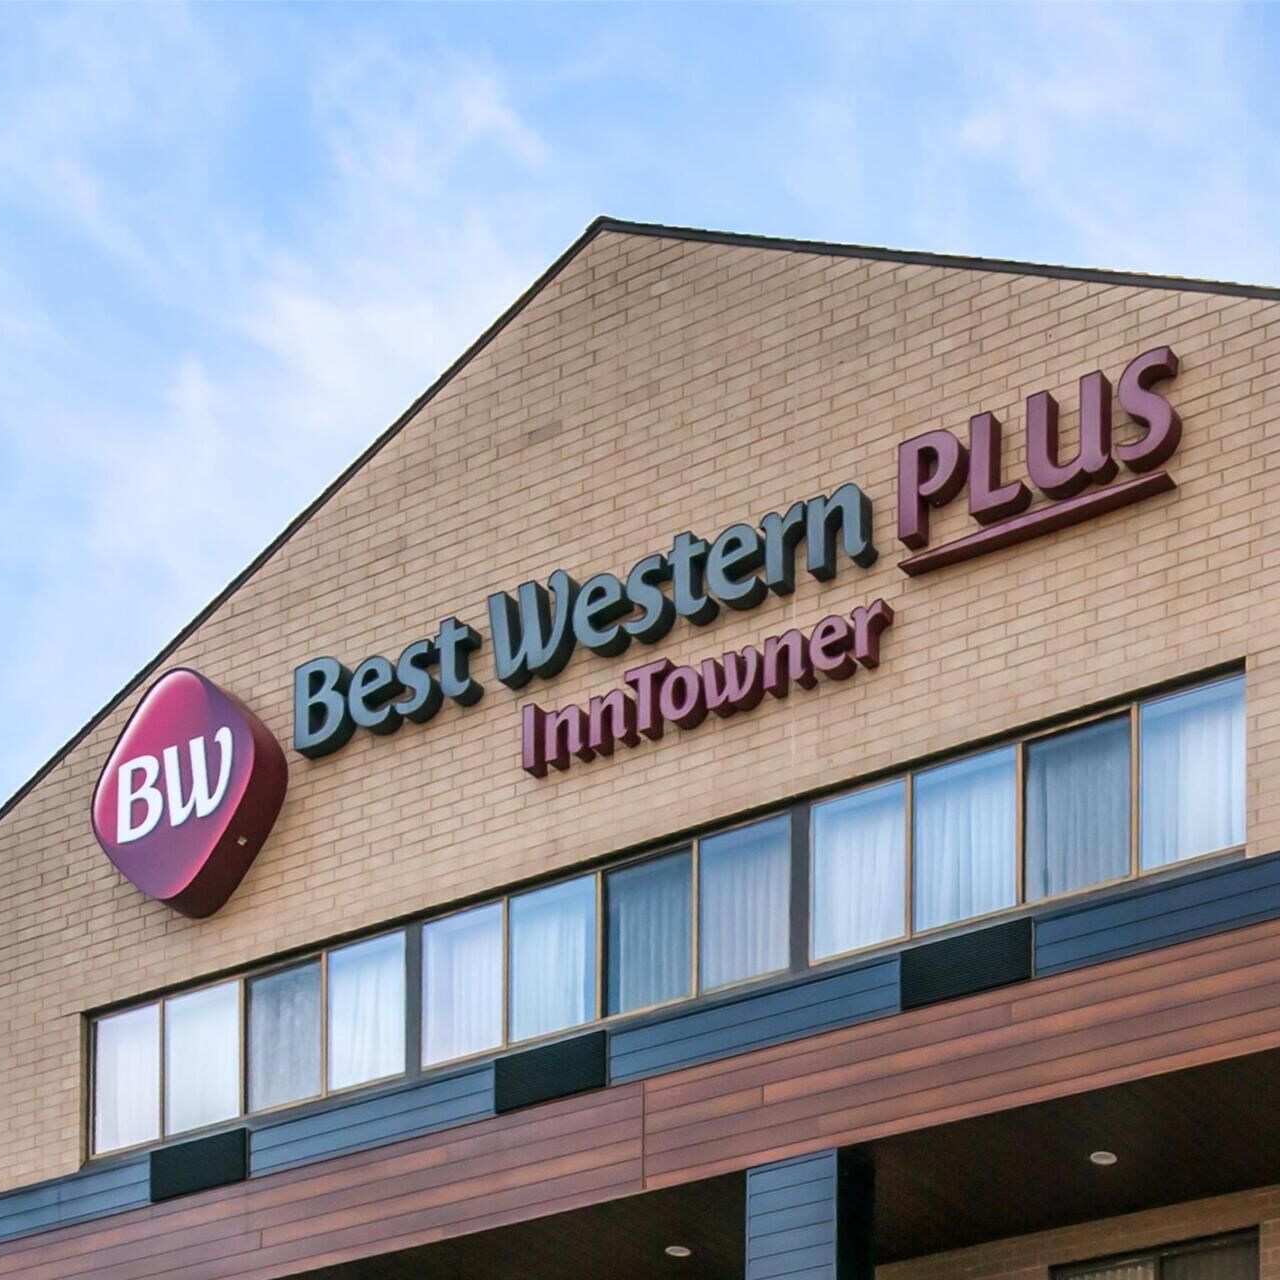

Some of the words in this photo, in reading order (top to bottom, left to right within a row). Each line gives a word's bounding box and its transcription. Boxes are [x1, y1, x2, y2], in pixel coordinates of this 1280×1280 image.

[294, 616, 484, 759] Best
[488, 483, 878, 690] Western
[898, 345, 1182, 550] PLUS
[522, 598, 894, 778] InnTowner
[117, 724, 233, 844] BW
